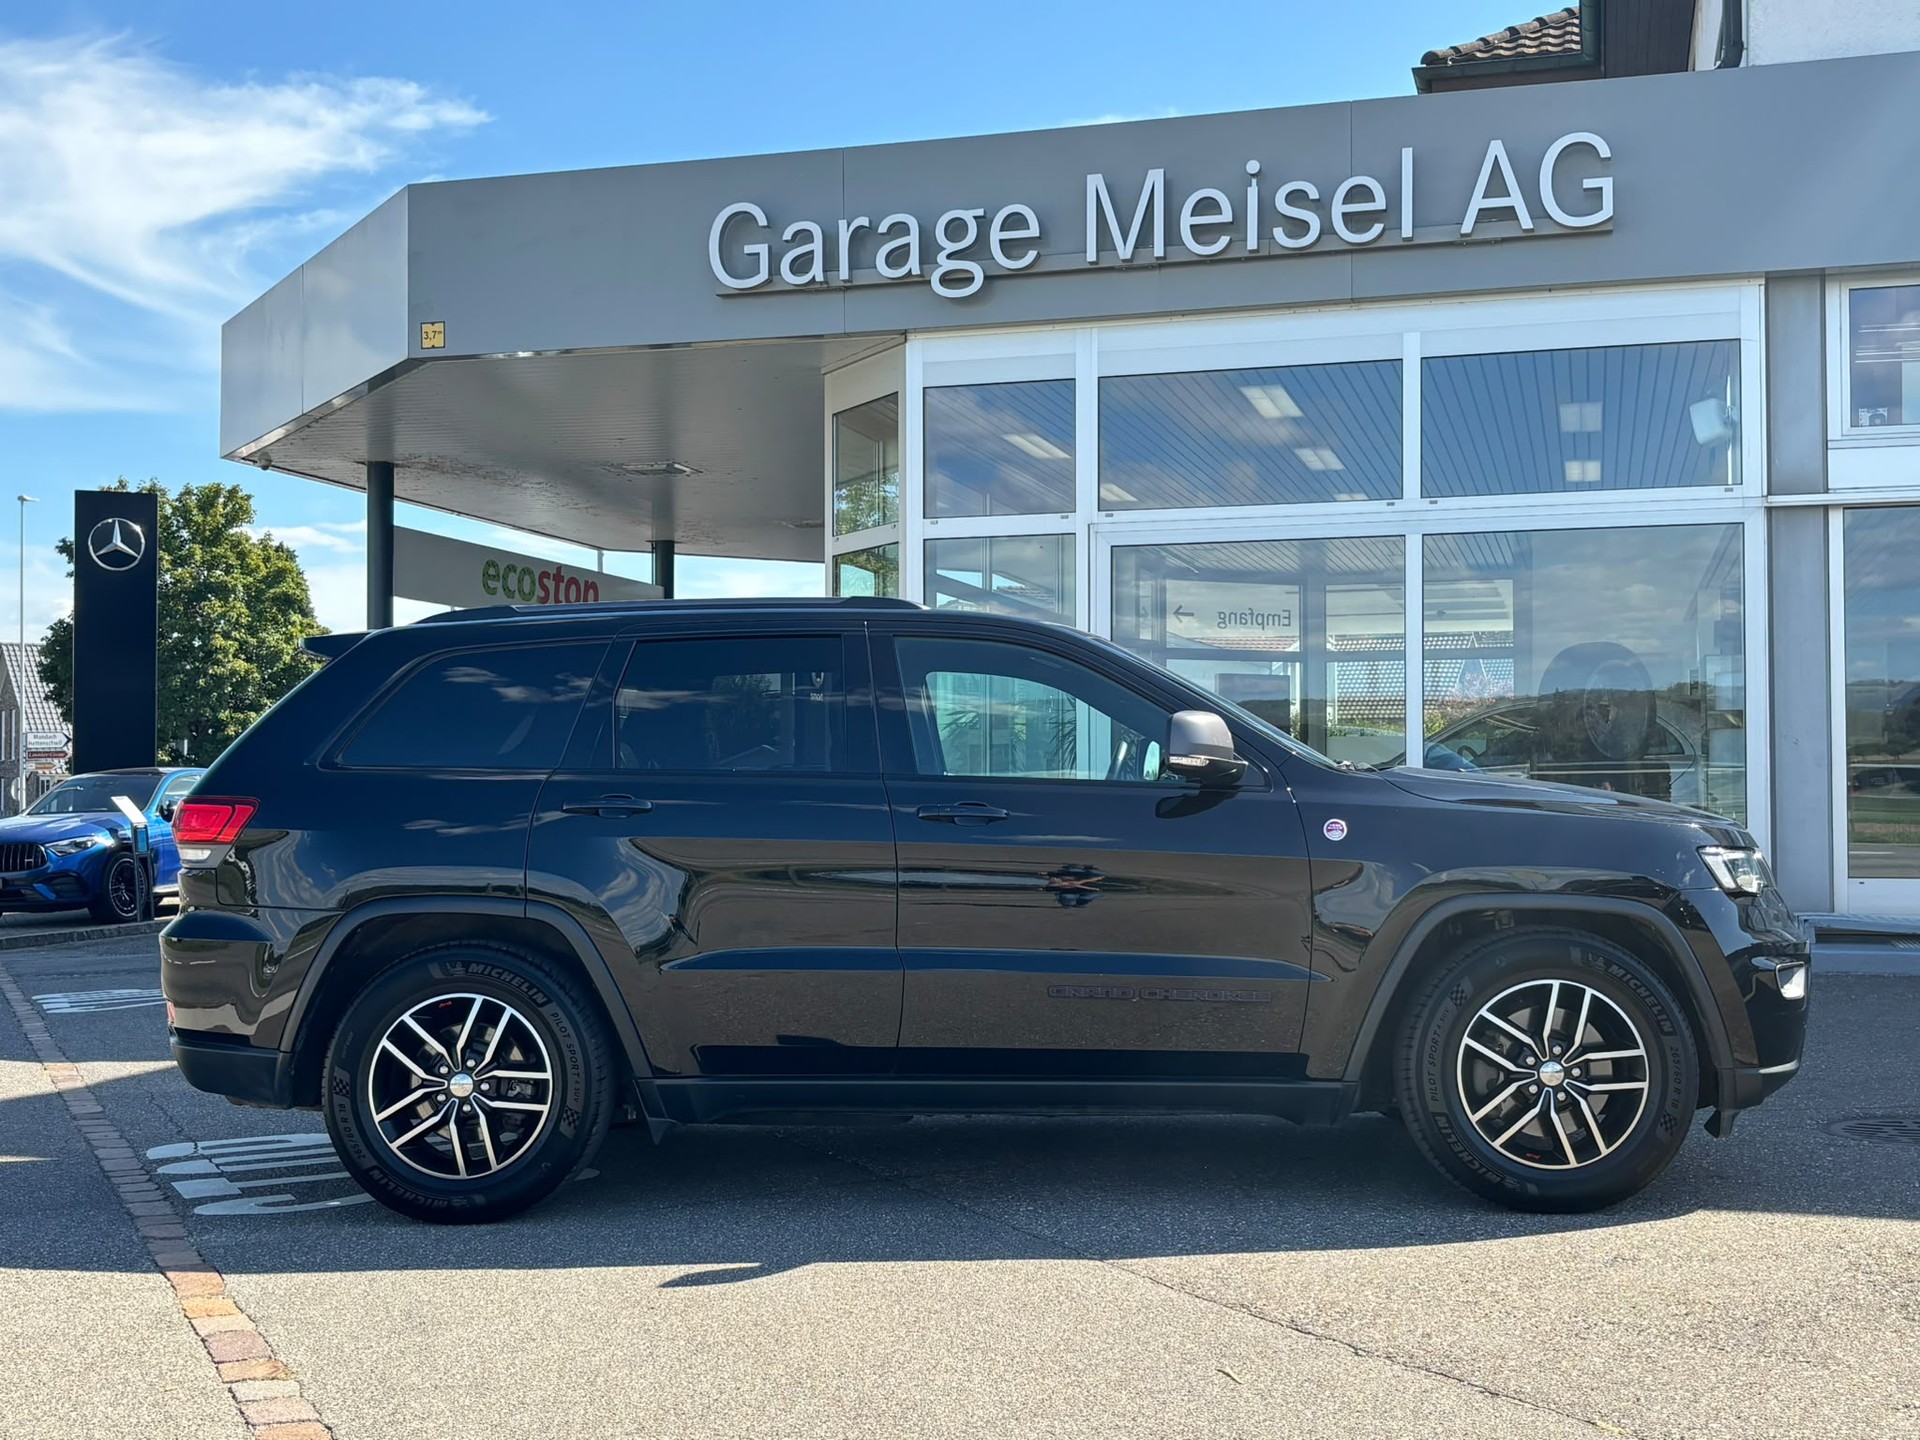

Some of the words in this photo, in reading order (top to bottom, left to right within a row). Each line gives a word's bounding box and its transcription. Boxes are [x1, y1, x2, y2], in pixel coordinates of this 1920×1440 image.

[708, 202, 1040, 298] Garage
[1086, 147, 1414, 263] Meisel
[1460, 132, 1615, 236] AG
[468, 963, 548, 1005] MICHELIN
[1608, 963, 1674, 1034] MICHELIN
[550, 1012, 571, 1038] PILOT
[566, 1043, 581, 1079] SPORT
[1428, 1030, 1441, 1067] SPORT
[1428, 1070, 1439, 1102] PILOT
[1435, 1114, 1503, 1184] MICHELIN
